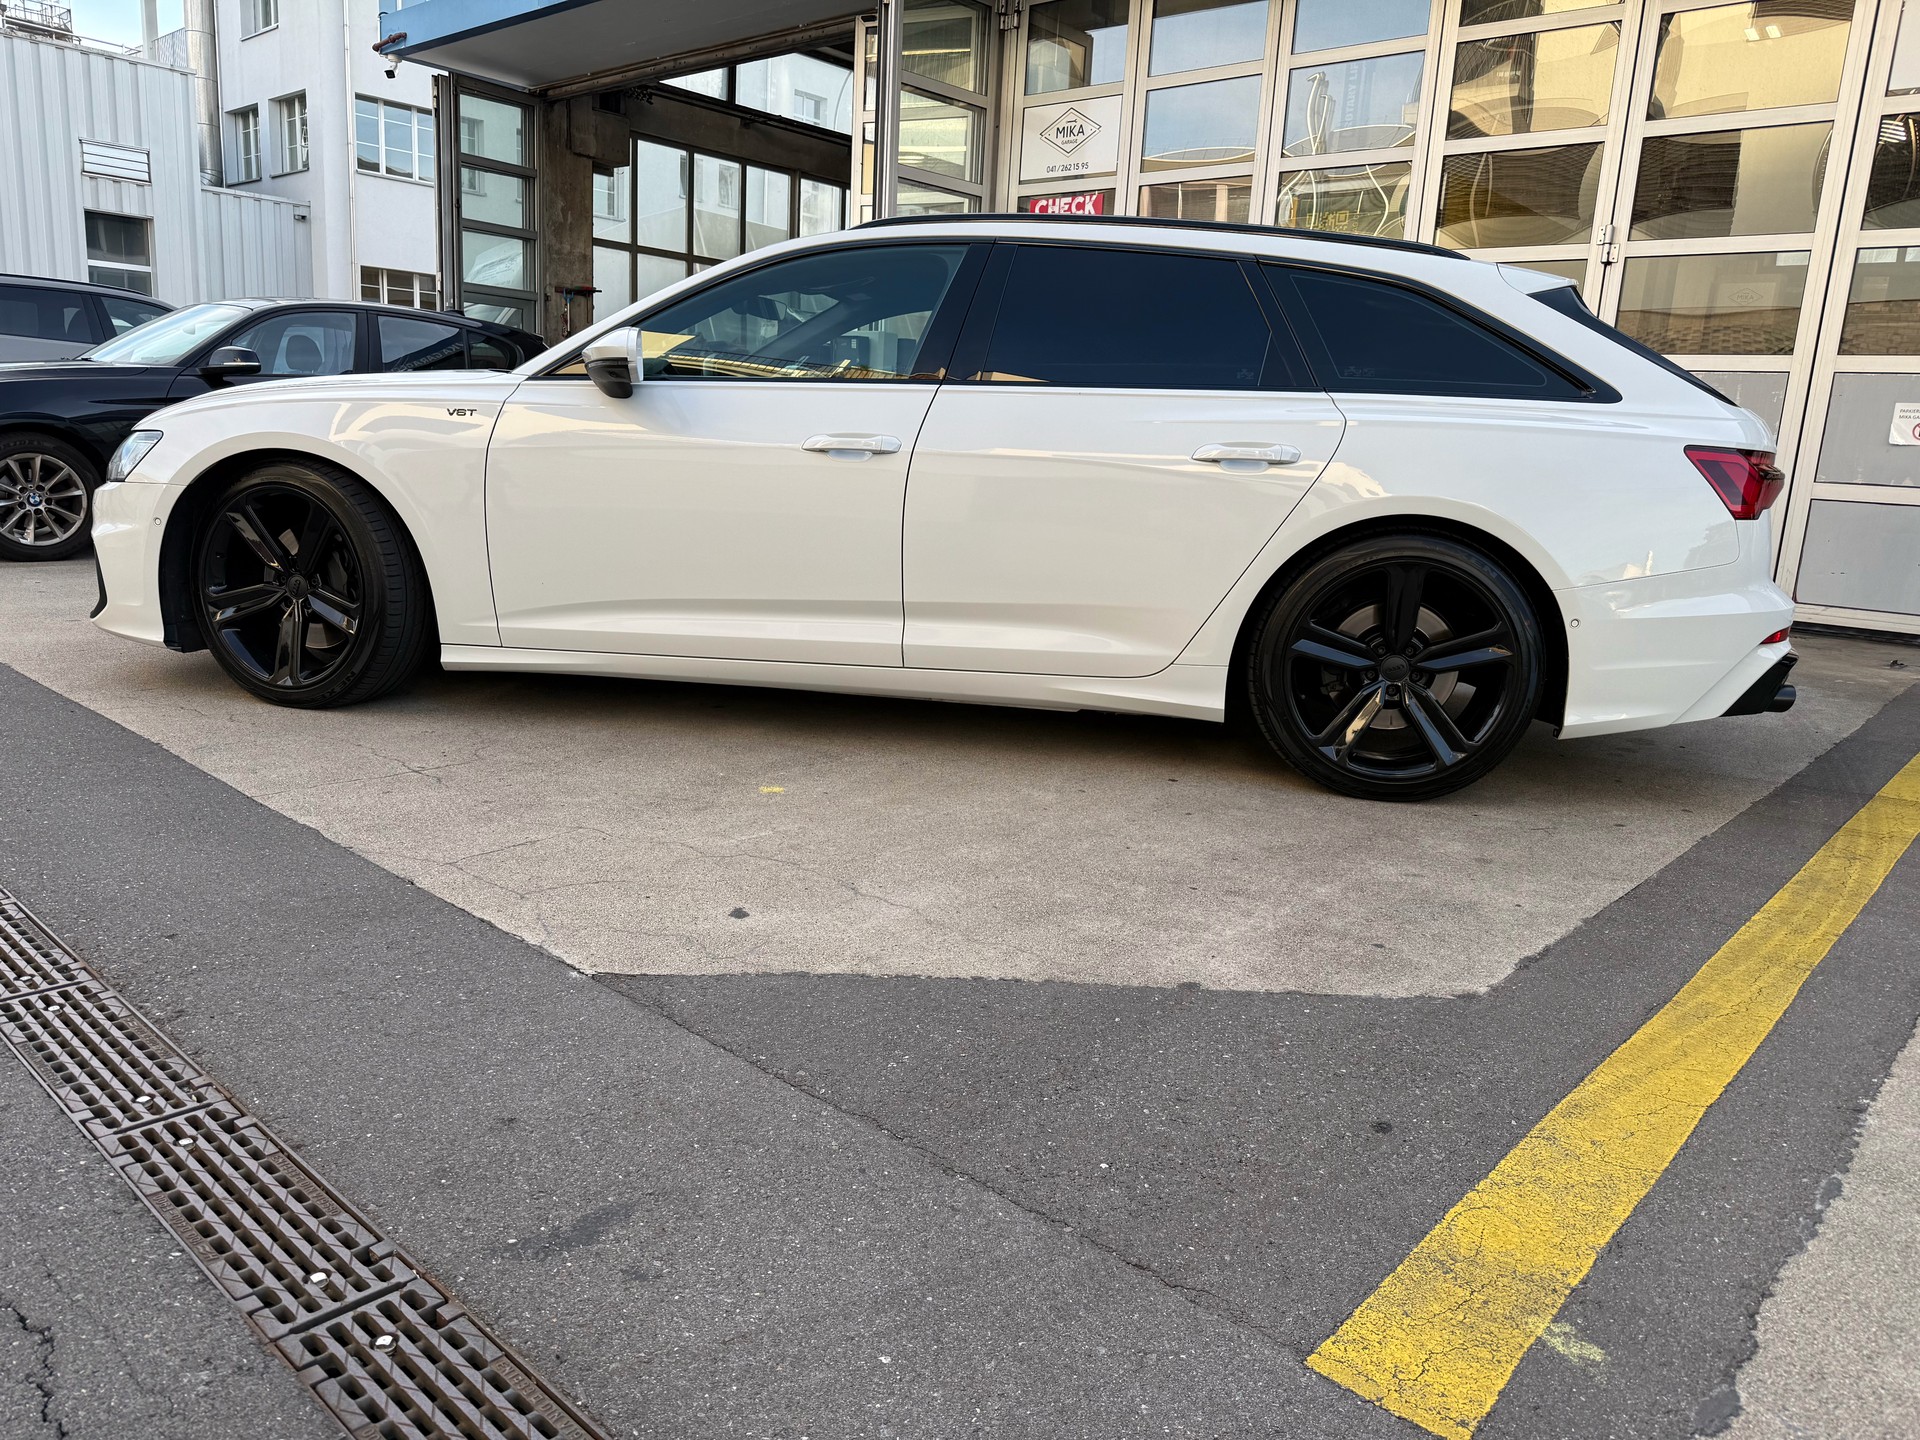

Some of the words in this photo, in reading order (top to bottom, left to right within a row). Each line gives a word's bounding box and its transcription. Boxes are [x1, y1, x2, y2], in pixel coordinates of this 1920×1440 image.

[1349, 63, 1359, 80] LIF
[1056, 124, 1085, 139] MIKA
[1034, 191, 1098, 214] CHECK
